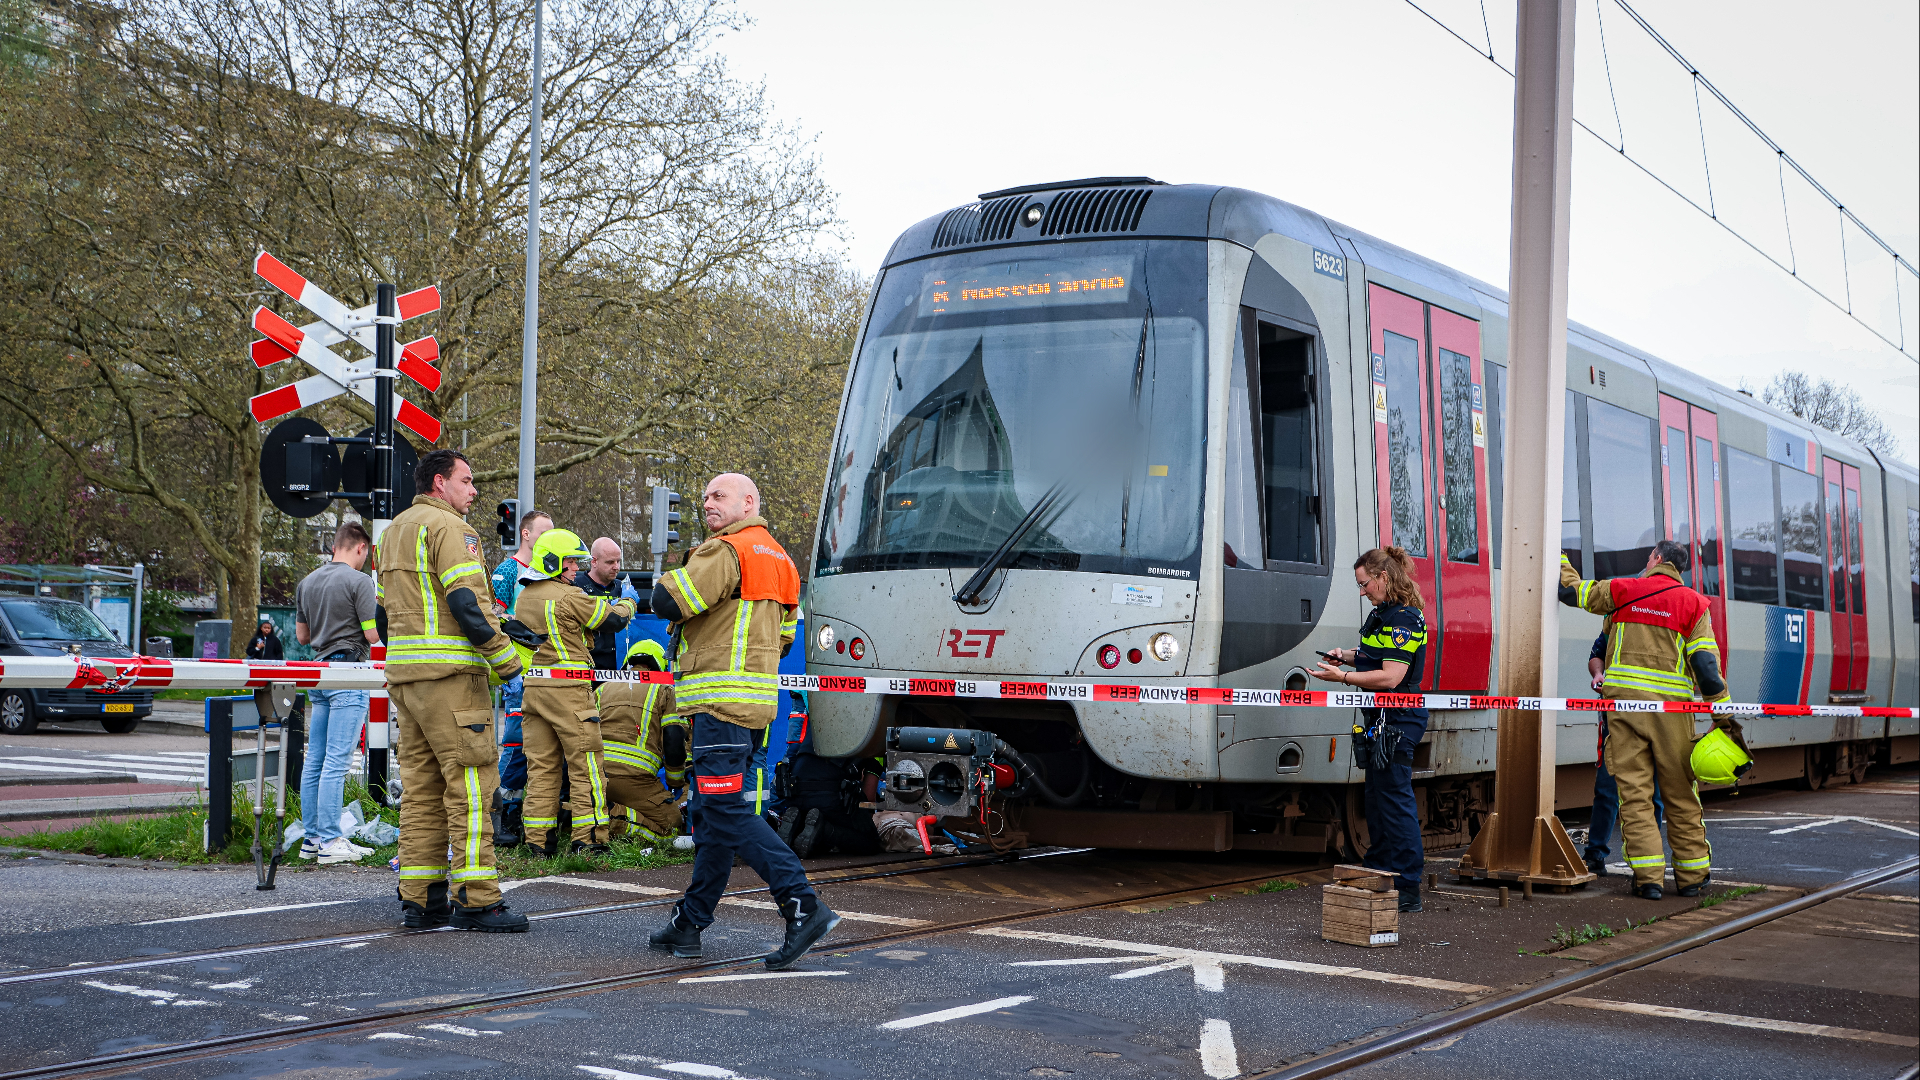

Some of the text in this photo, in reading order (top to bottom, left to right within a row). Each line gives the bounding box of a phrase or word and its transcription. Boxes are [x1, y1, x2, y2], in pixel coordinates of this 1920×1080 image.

[1314, 250, 1343, 277] 5623
[1147, 567, 1191, 578] BOMBARDIER
[1631, 605, 1672, 618] Bevelvoerder
[1785, 613, 1804, 643] RET
[945, 628, 1006, 658] RET
[566, 669, 651, 682] BRANDWEER
[780, 675, 867, 690] BRANDWEER
[889, 679, 976, 694] BRANDWEER
[1000, 683, 1087, 698] BRANDWEER
[1110, 686, 1199, 702] BRANDWEER
[1222, 690, 1312, 705] BRANDWEER
[1335, 693, 1426, 708] BRANDWEER
[1450, 697, 1541, 710] BRANDWEER
